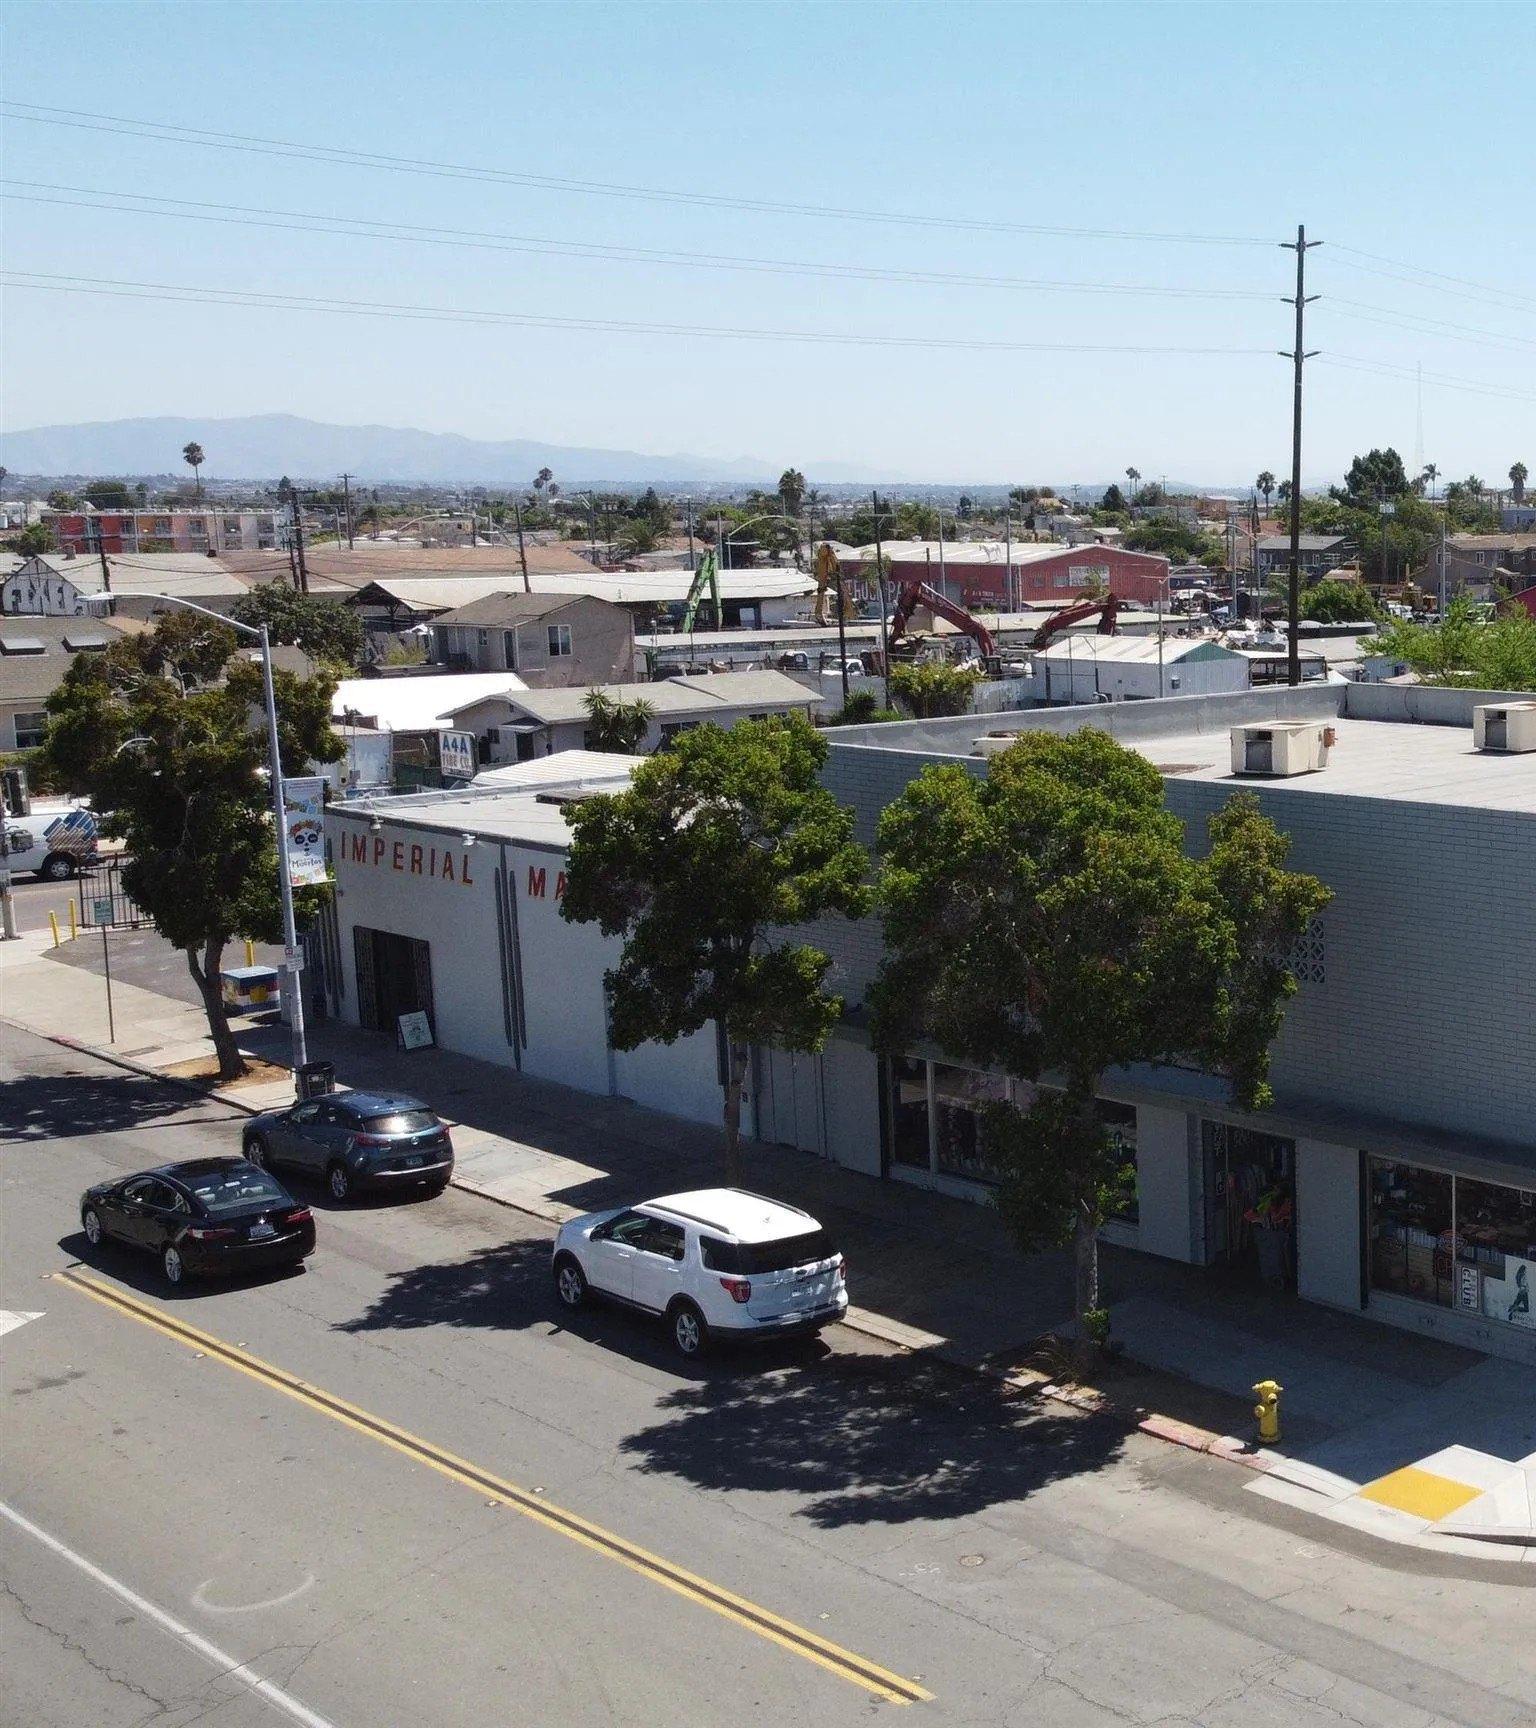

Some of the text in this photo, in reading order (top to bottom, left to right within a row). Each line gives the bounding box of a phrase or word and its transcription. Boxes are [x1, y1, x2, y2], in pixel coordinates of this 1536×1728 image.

[443, 734, 468, 754] A4A
[341, 831, 567, 900] IMPERIAL MA
[1463, 1268, 1471, 1306] CLUB
